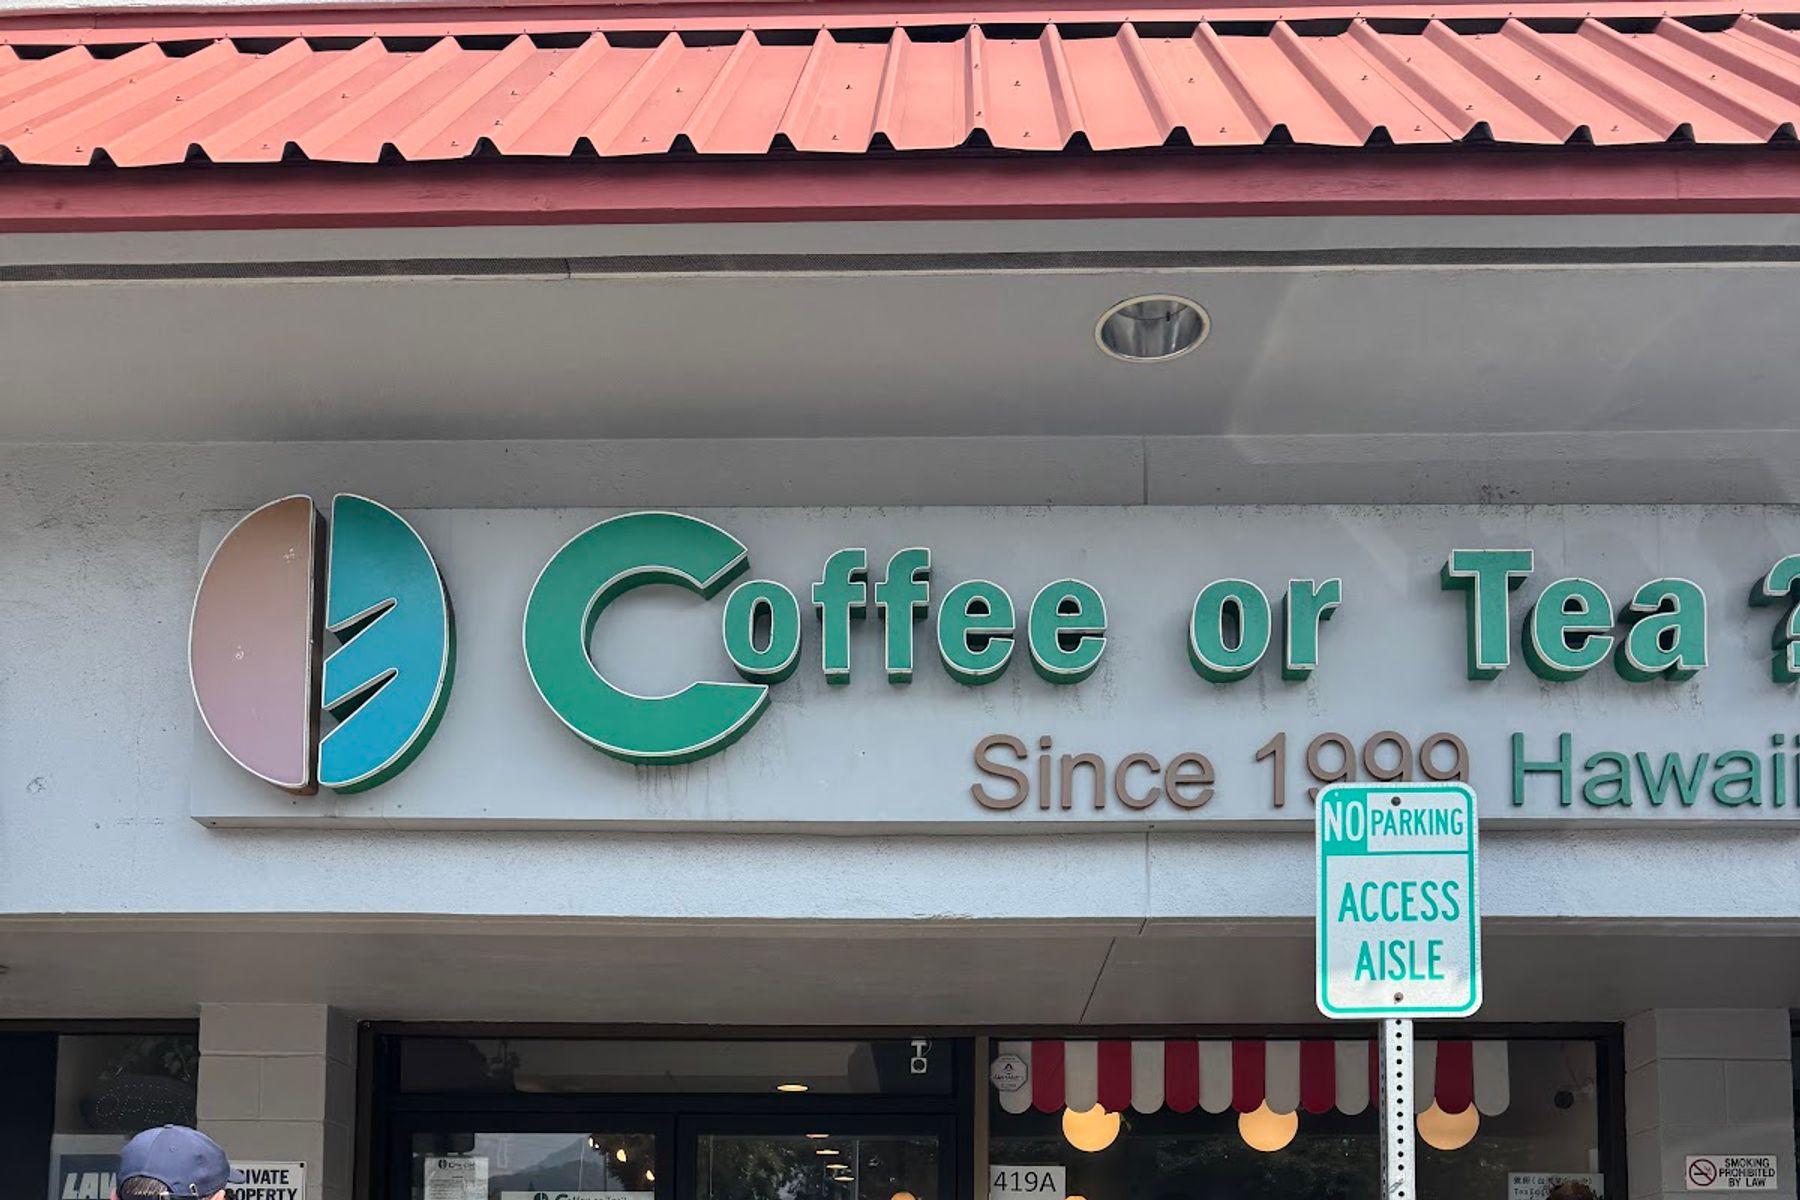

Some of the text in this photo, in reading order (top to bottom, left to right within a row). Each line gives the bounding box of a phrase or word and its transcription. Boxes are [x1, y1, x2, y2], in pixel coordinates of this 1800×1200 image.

[522, 510, 1108, 767] Coffee
[1187, 577, 1342, 683] or
[1441, 548, 1709, 682] Tea
[970, 731, 1800, 811] Since 1999 Hawai
[1324, 800, 1464, 842] NO PARKING
[1338, 880, 1460, 923] ACCESS
[1354, 940, 1444, 981] AISLE
[239, 1169, 290, 1184] IVATE
[1719, 1168, 1775, 1177] PROHIBITED
[1724, 1158, 1770, 1168] SMOKING
[994, 1171, 1056, 1193] 419A
[1728, 1178, 1766, 1187] BY LAW
